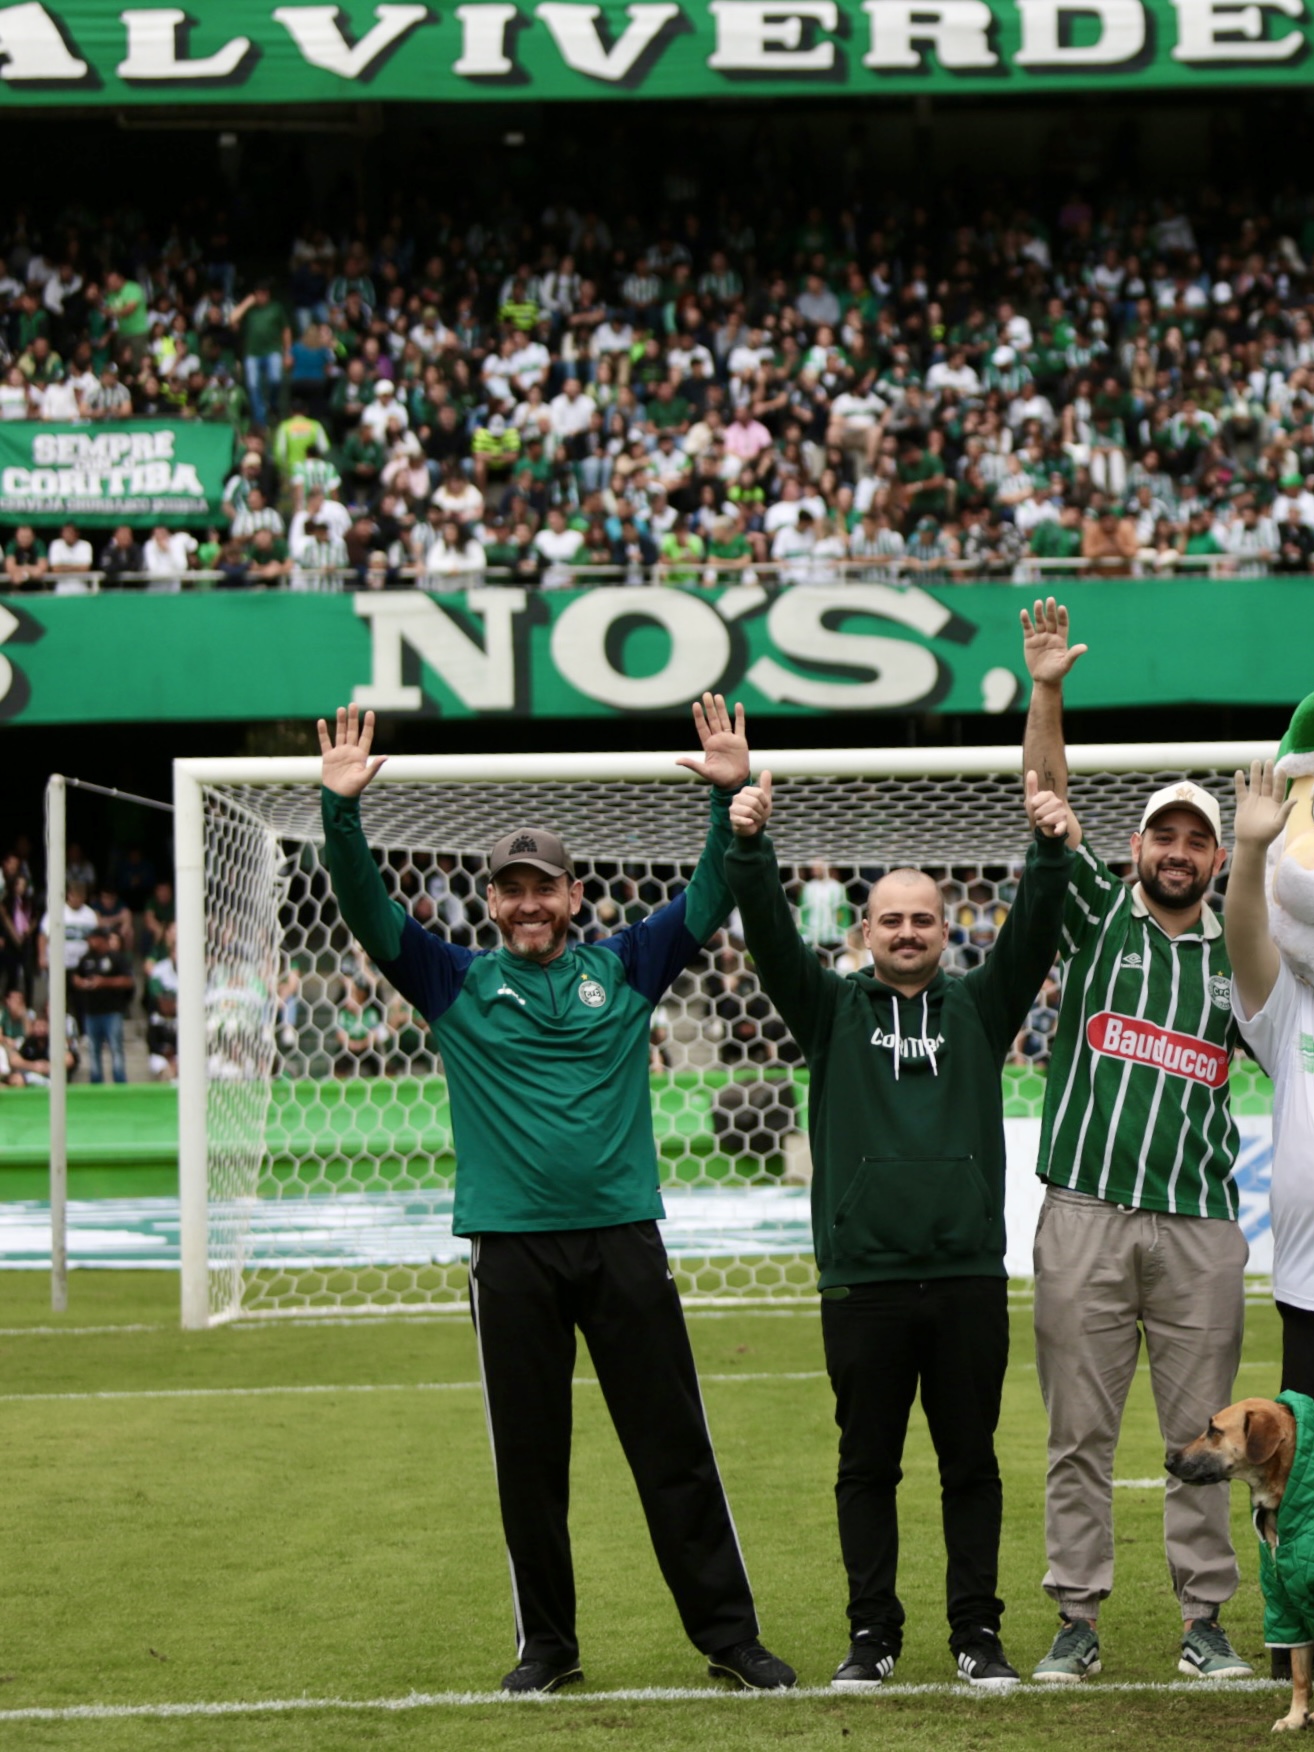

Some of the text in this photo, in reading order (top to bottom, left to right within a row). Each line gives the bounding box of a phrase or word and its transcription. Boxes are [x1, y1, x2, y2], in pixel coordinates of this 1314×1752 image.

[0, 0, 1305, 81] ALVIVERDE
[33, 430, 175, 466] SEMPRE
[3, 461, 204, 496] CORITIBA
[1102, 1018, 1218, 1082] Bauducco
